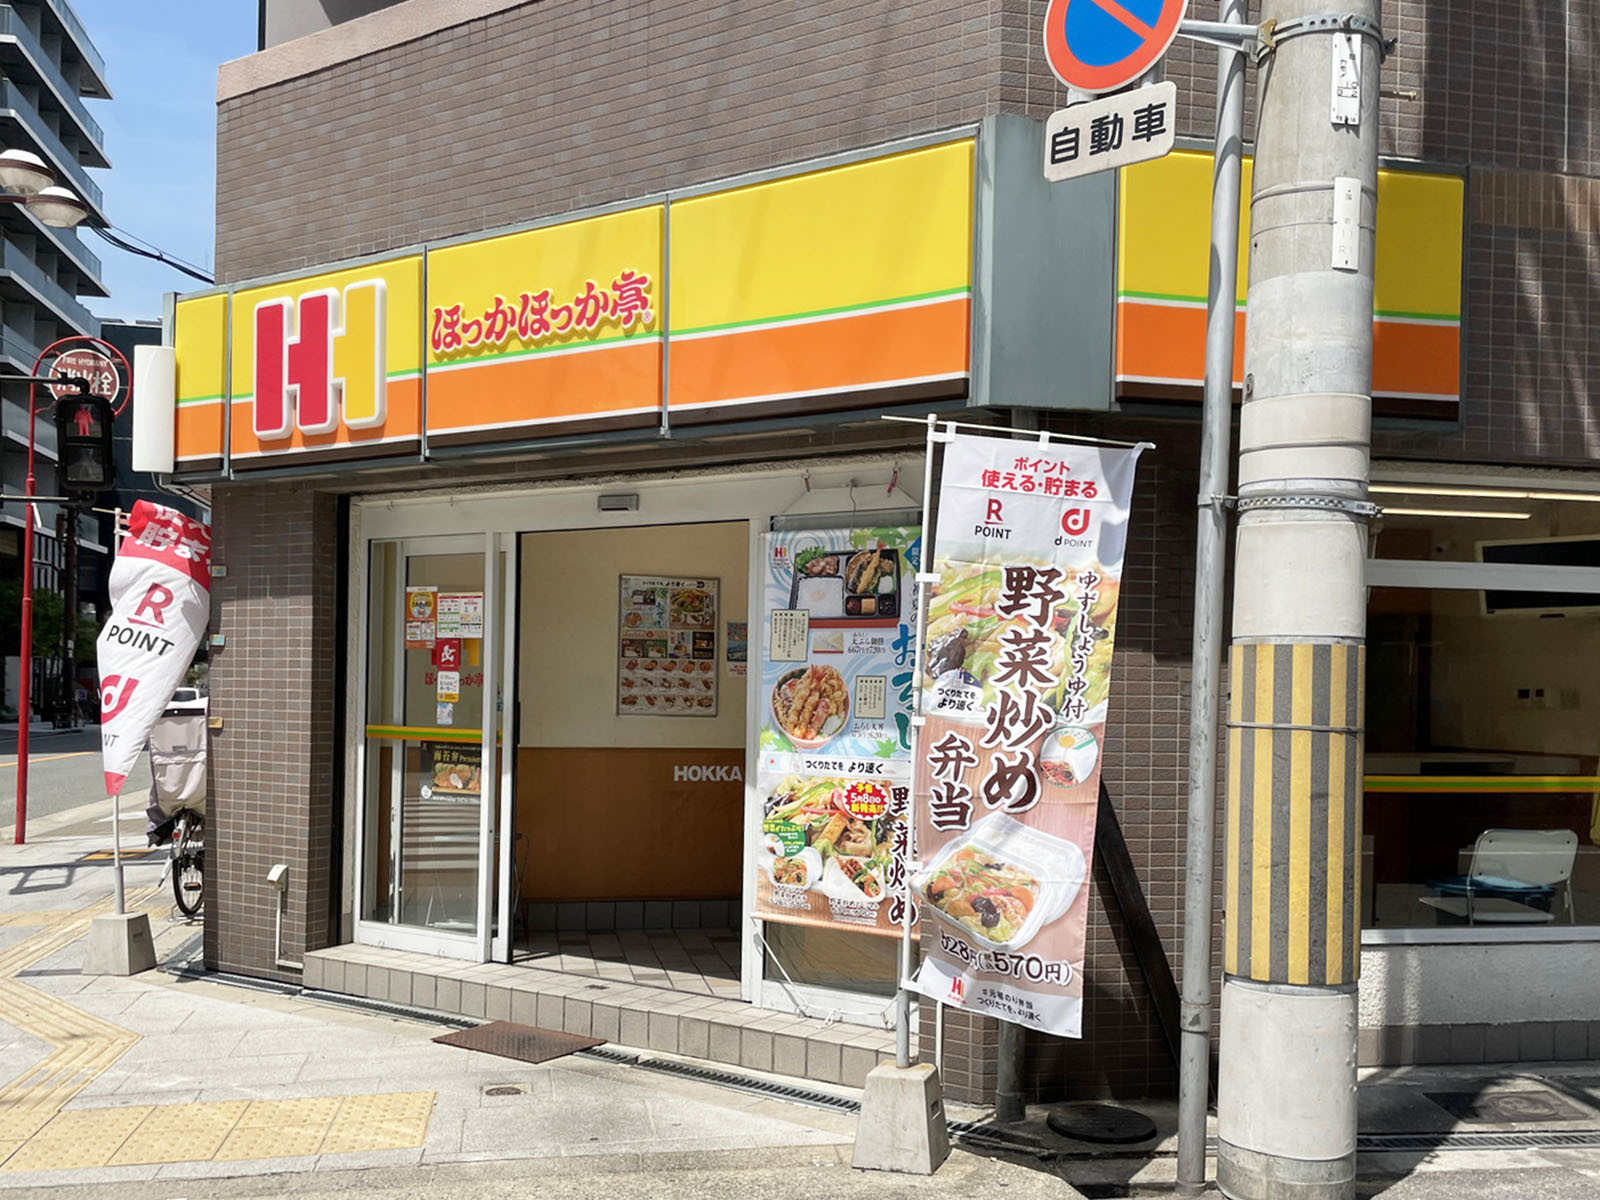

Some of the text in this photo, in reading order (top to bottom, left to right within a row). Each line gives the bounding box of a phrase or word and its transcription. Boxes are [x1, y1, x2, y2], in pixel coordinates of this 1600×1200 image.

[1050, 102, 1167, 165] 自動車
[431, 270, 650, 351] ほっかほっか亭
[62, 356, 77, 365] FIRE
[1013, 456, 1071, 476] ポイント
[974, 524, 1012, 540] POINT
[1063, 538, 1094, 548] POINT
[134, 521, 211, 575] 貯ま
[106, 624, 176, 657] POINT
[1061, 570, 1100, 720] ゆずしょうゆ付
[983, 566, 1065, 809] 野菜炒め
[937, 697, 975, 711] より速く
[673, 765, 743, 782] HOKKA
[805, 759, 884, 774] つくりたてを より速く
[930, 734, 977, 830] 弁当
